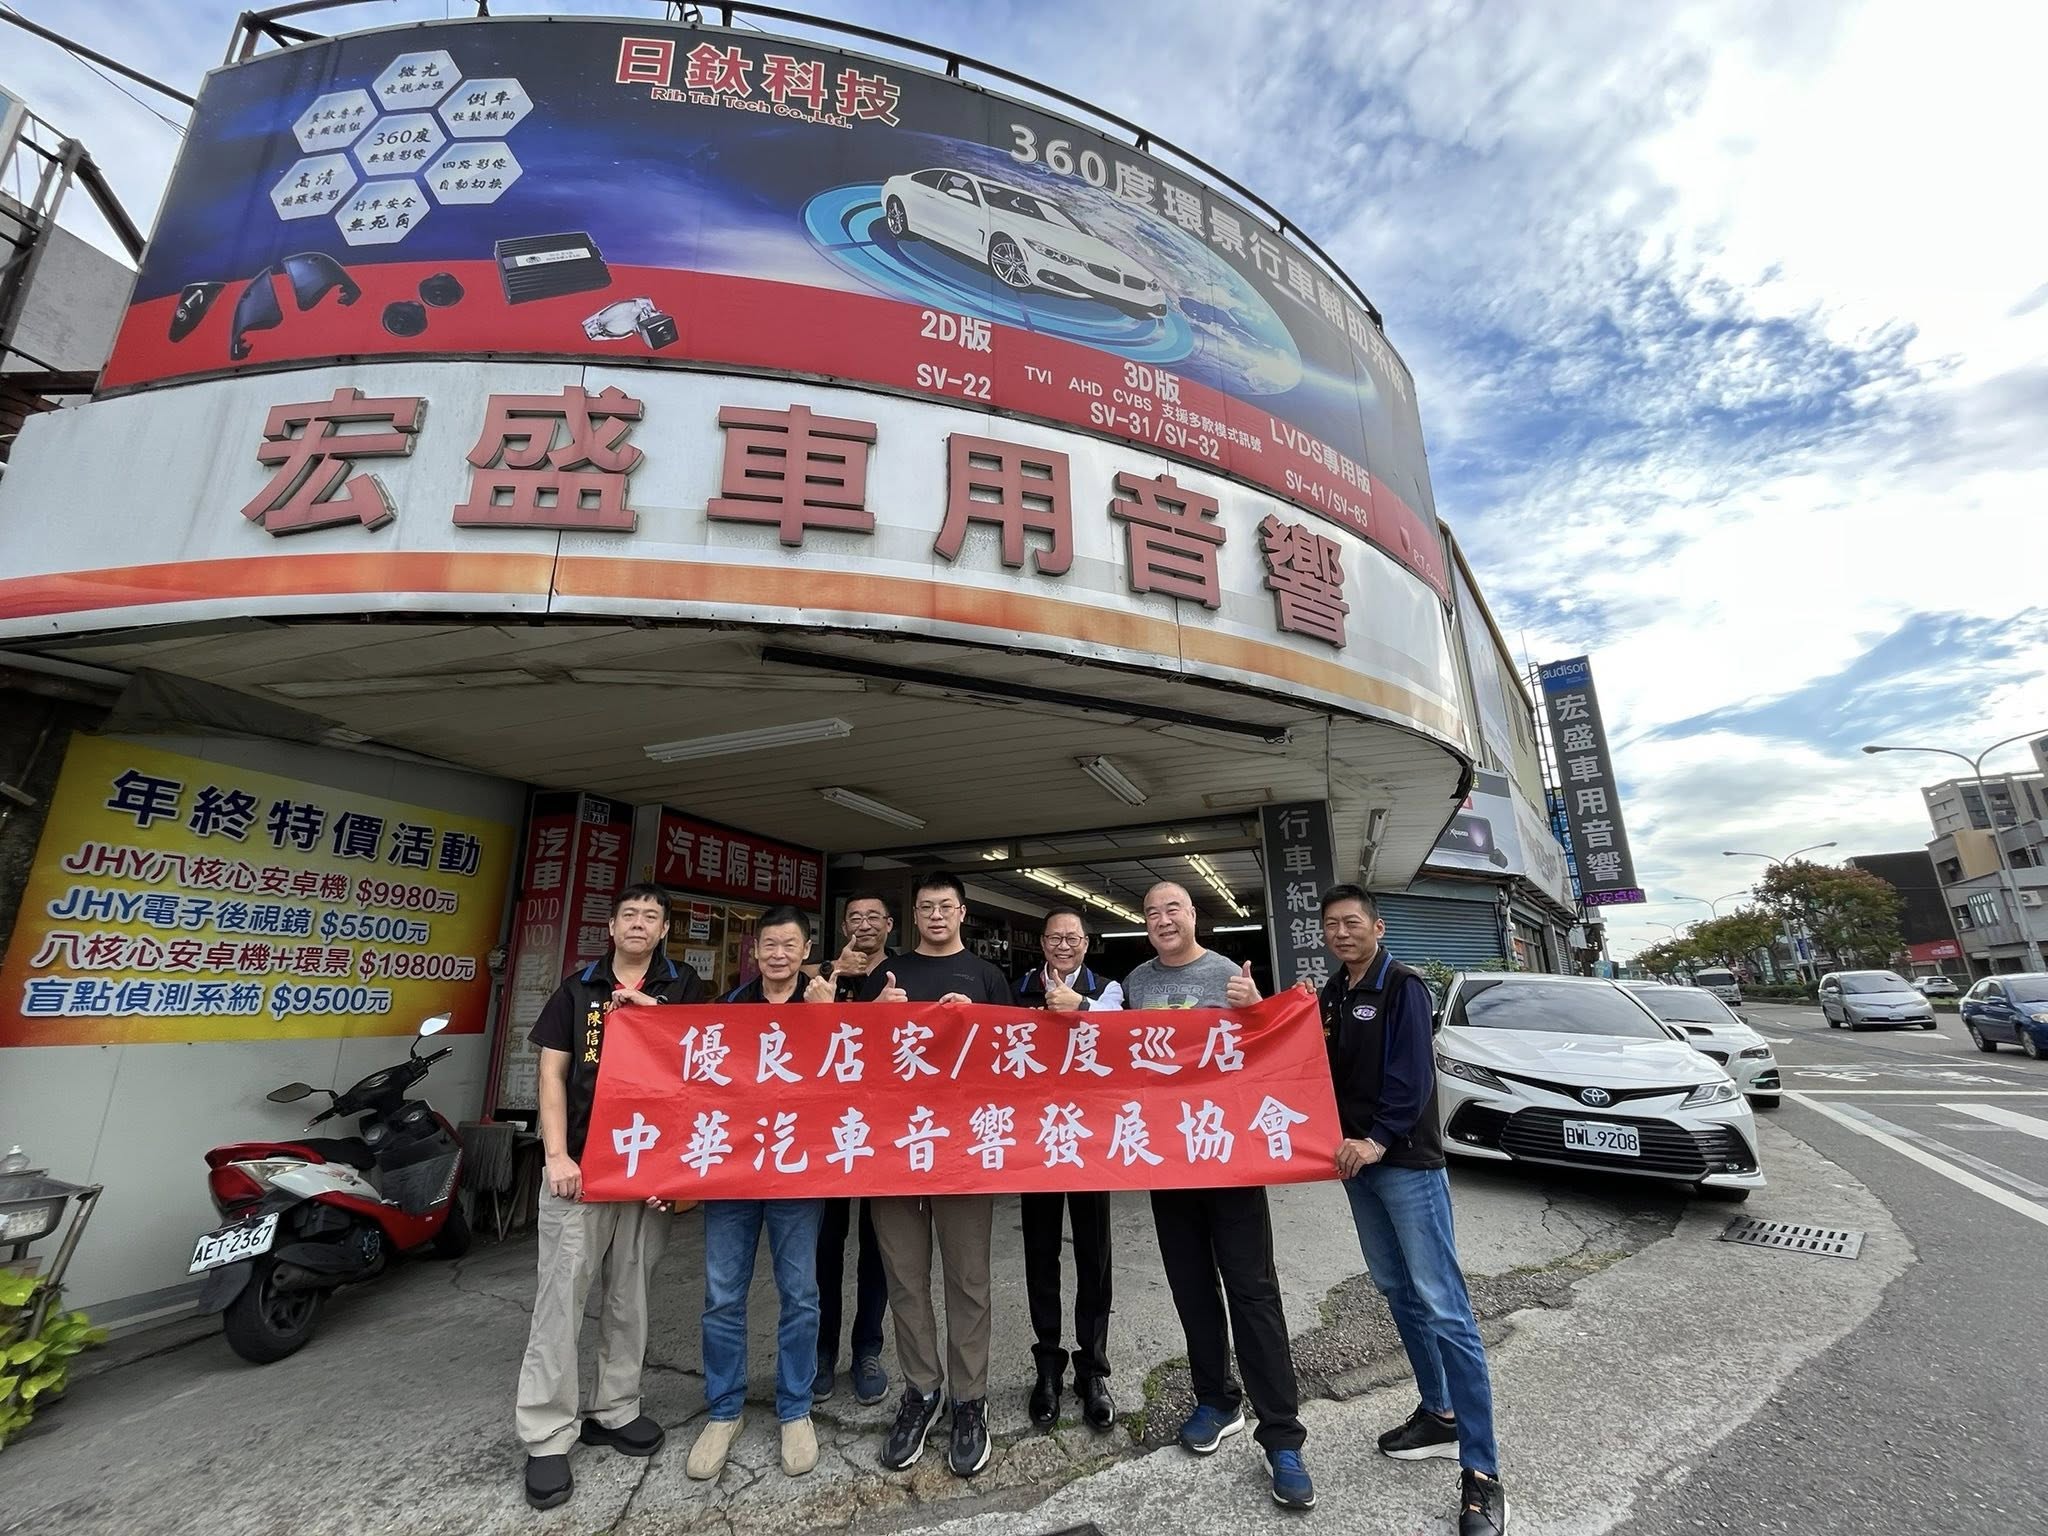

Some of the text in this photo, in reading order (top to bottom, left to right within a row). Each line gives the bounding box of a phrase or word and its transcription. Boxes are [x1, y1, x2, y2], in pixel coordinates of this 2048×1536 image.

[467, 91, 510, 106] 倒車
[615, 37, 900, 127] 日鈦科技
[651, 87, 687, 101] Rih
[723, 96, 770, 114] Tech
[373, 128, 431, 146] 360度
[294, 169, 334, 188] 高清
[440, 178, 503, 191] 自動切換
[442, 158, 507, 170] 四路影像
[347, 212, 410, 232] 無死角
[353, 197, 416, 211] 行車安全
[920, 310, 992, 353] 2D版
[917, 363, 992, 400] SV-22
[1024, 365, 1153, 412] TVI AHD CVBS
[1123, 361, 1182, 405] 3D版
[1161, 402, 1263, 453] 支援多款模式訊號
[1269, 417, 1372, 496] LVDS專用版
[241, 385, 1350, 649] 宏盛車用音響
[1542, 662, 1589, 680] audison
[1555, 693, 1623, 882] 宏盛車用音響
[107, 768, 482, 875] 年終特價活動
[66, 844, 457, 912] JHY八核心安卓機 $9980元
[532, 827, 569, 891] 汽車
[664, 825, 819, 901] 汽車隔音制震
[52, 887, 428, 942] JHY電子後視鏡 $5500元
[527, 897, 560, 922] DVD
[574, 829, 621, 971] 汽車音響
[1278, 809, 1330, 989] 行車紀錄器
[33, 933, 475, 977] 八核心安卓機+環景 $19800元
[524, 923, 554, 947] VCD
[26, 980, 390, 1017] 盲點偵測系統 $9500元
[583, 1010, 603, 1064] 陳信成
[678, 1019, 1244, 1087] 優良店家/深度巡店
[611, 1095, 1310, 1179] 中華汽車音響發展協會
